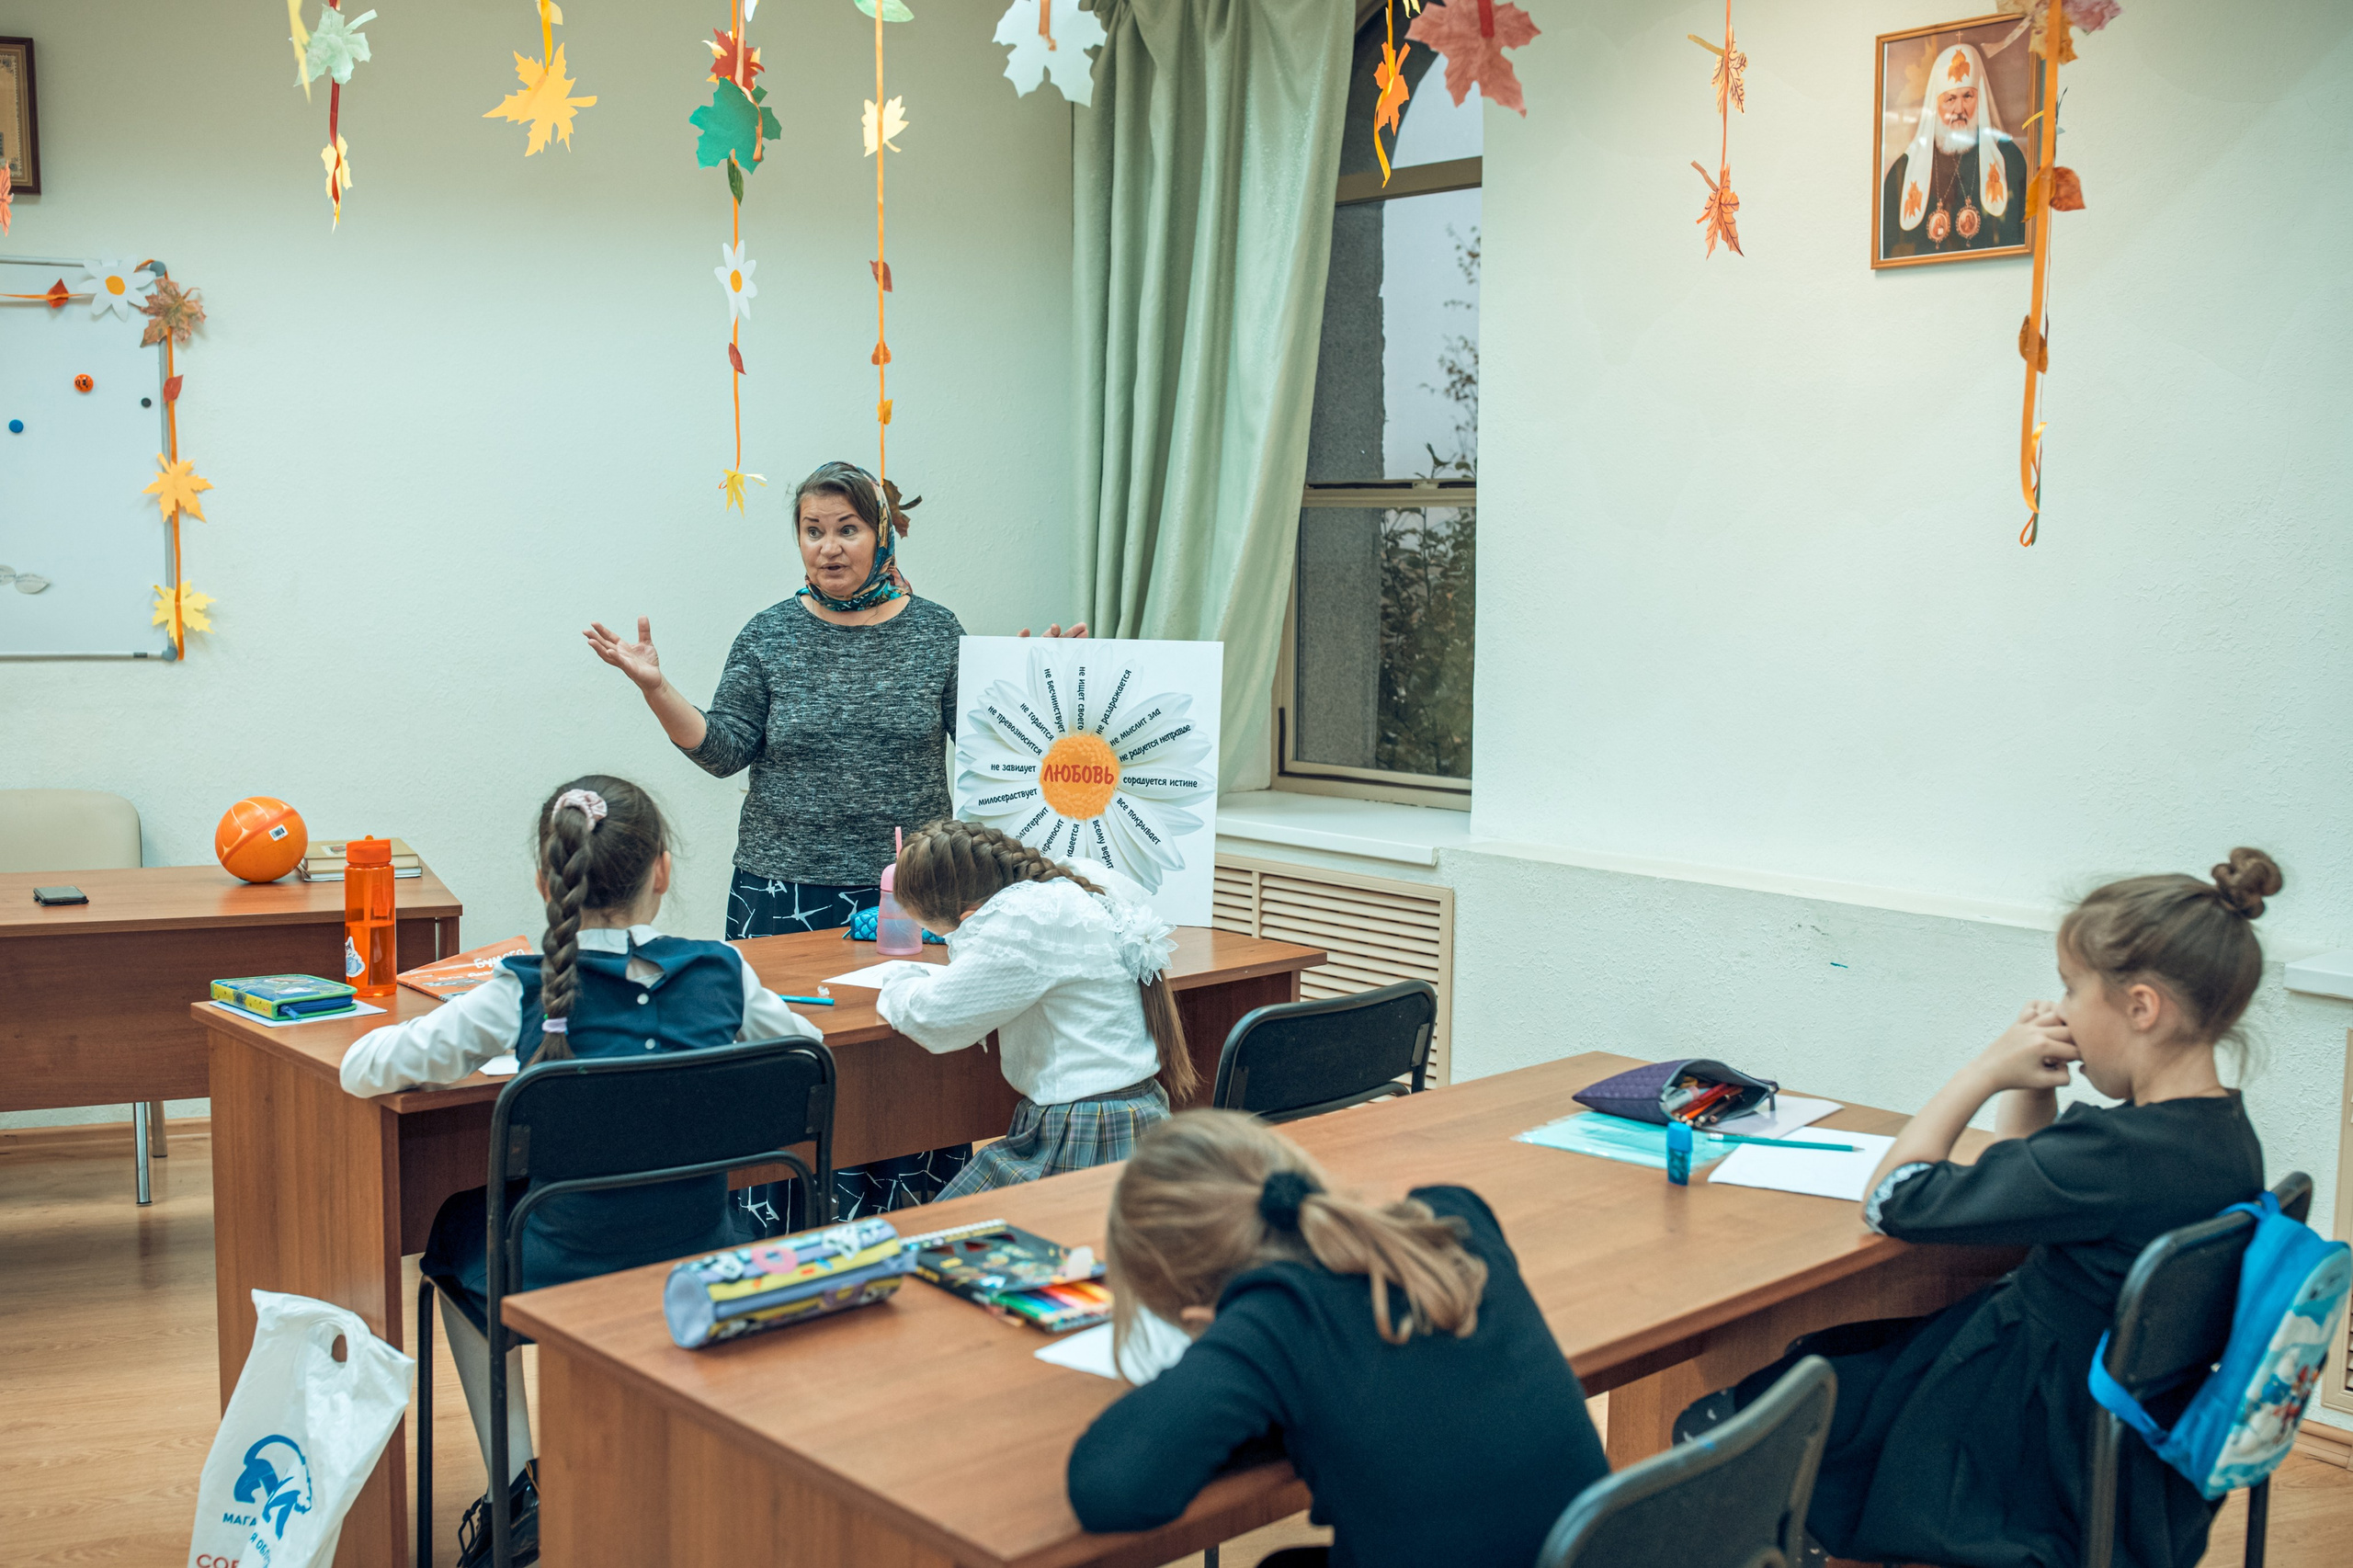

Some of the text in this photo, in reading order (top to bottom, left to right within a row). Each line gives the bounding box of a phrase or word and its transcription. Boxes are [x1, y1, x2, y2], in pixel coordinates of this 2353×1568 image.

[1077, 679, 1086, 701] ищет
[1078, 666, 1086, 676] не
[1044, 668, 1065, 733] не бесчинствует
[1096, 669, 1132, 735] не раздражается
[987, 706, 1043, 756] не превозносится
[1020, 702, 1055, 742] не гордится
[1109, 708, 1161, 747] не мыслит зла
[1120, 724, 1191, 762] не радуется неправде
[1002, 764, 1037, 774] завидует
[1043, 764, 1115, 785] ЛЮБОВЬ
[1122, 776, 1198, 788] сорадуется истине
[978, 788, 1038, 806] милосердствует
[1015, 806, 1050, 841] олготерпит
[1116, 797, 1162, 845] все покрывает
[1092, 819, 1114, 869] всему верит
